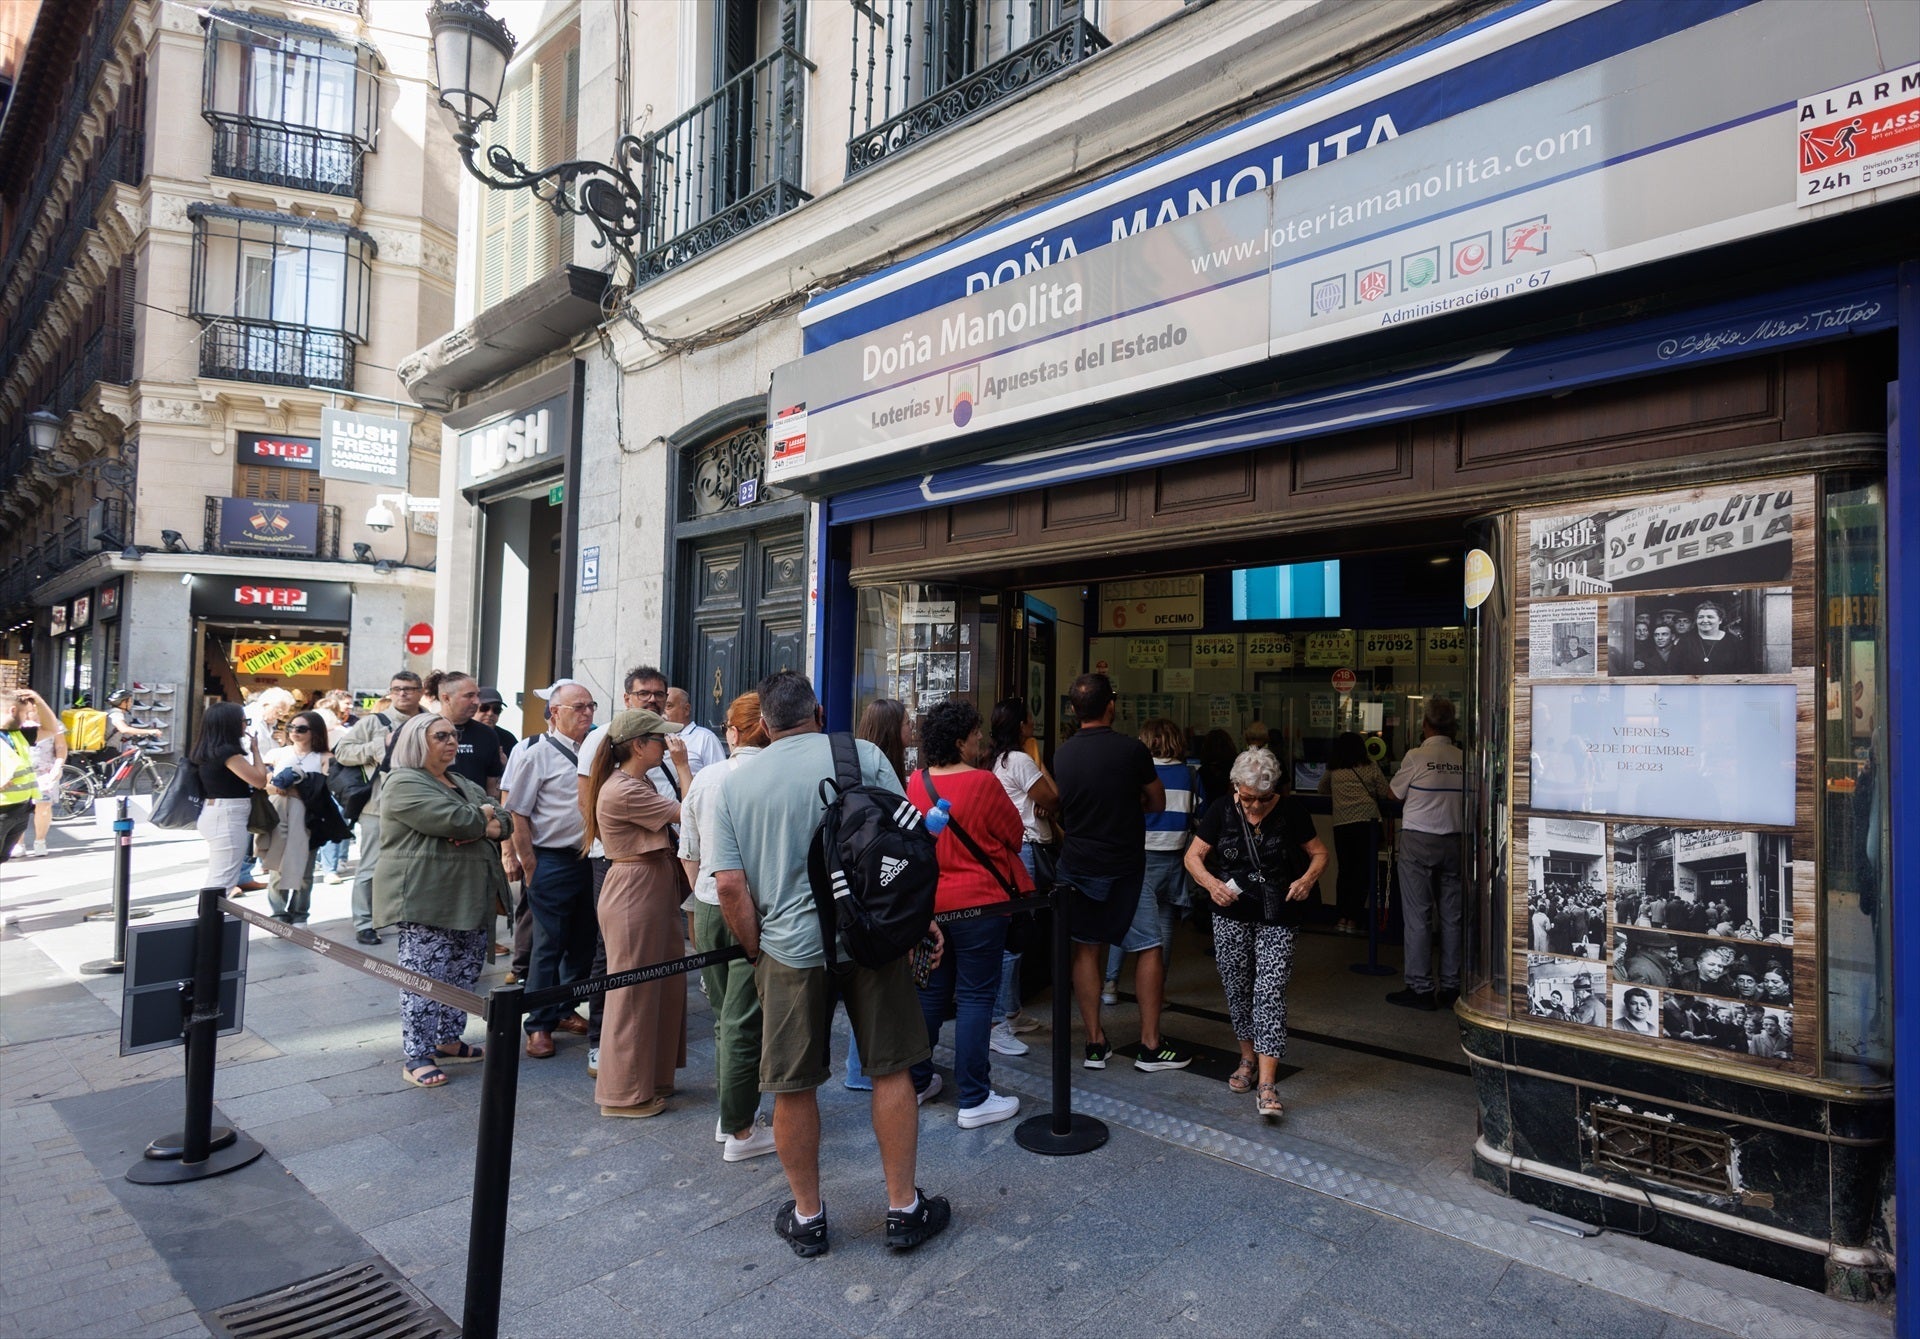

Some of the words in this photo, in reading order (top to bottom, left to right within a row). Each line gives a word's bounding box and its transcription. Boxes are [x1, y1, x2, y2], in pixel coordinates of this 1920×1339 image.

[1863, 158, 1893, 171] División
[1894, 155, 1904, 163] de
[1876, 165, 1898, 178] 900
[1900, 160, 1919, 171] 321
[1808, 172, 1851, 196] 24h
[1191, 123, 1593, 275] www.loteriamanolita.com
[966, 236, 1079, 297] DOÑA
[1381, 286, 1499, 326] Administración
[1505, 277, 1523, 294] nº
[1528, 270, 1551, 289] 67
[863, 332, 932, 382] Doña
[940, 282, 1083, 356] Manolita
[871, 398, 930, 429] Loterías
[934, 396, 944, 418] y
[983, 358, 1068, 400] Apuestas
[1074, 343, 1105, 373] del
[1111, 324, 1187, 363] Estado
[331, 420, 398, 444] LUSH
[257, 440, 310, 458] STEP
[331, 436, 398, 458] FRESH
[471, 408, 549, 477] LUSH
[331, 450, 398, 467] HANDMADE
[331, 458, 397, 475] COSMETICS
[742, 484, 753, 500] 22
[242, 529, 253, 538] LA
[254, 533, 296, 543] ESPAÑOLA
[1538, 527, 1597, 550] DESDE
[1608, 513, 1793, 578] LOTERIA
[1546, 560, 1588, 580] 1904
[239, 585, 302, 606] STEP
[1104, 582, 1136, 598] ESTE
[1144, 578, 1195, 595] SORTEO
[1113, 606, 1126, 628] 6
[1136, 602, 1147, 614] €
[1154, 613, 1195, 625] DECIMO
[1310, 639, 1350, 649] 24914
[1368, 640, 1413, 651] 87092
[1377, 633, 1410, 641] PREMIO
[1195, 644, 1234, 655] 36142
[1250, 643, 1291, 654] 25296
[1612, 726, 1670, 738] VIERNES
[1585, 743, 1600, 753] 22
[1602, 743, 1619, 754] DE
[1622, 744, 1695, 757] DICIEMBRE
[1426, 761, 1463, 771] Serba
[1616, 761, 1633, 771] DE
[1635, 762, 1664, 772] 2023
[880, 858, 909, 887] adidas
[363, 958, 433, 992] WWW.LOTERIAMANOLITA.COM
[572, 956, 706, 996] WWW.LOTERIAMANOLITA.COM
